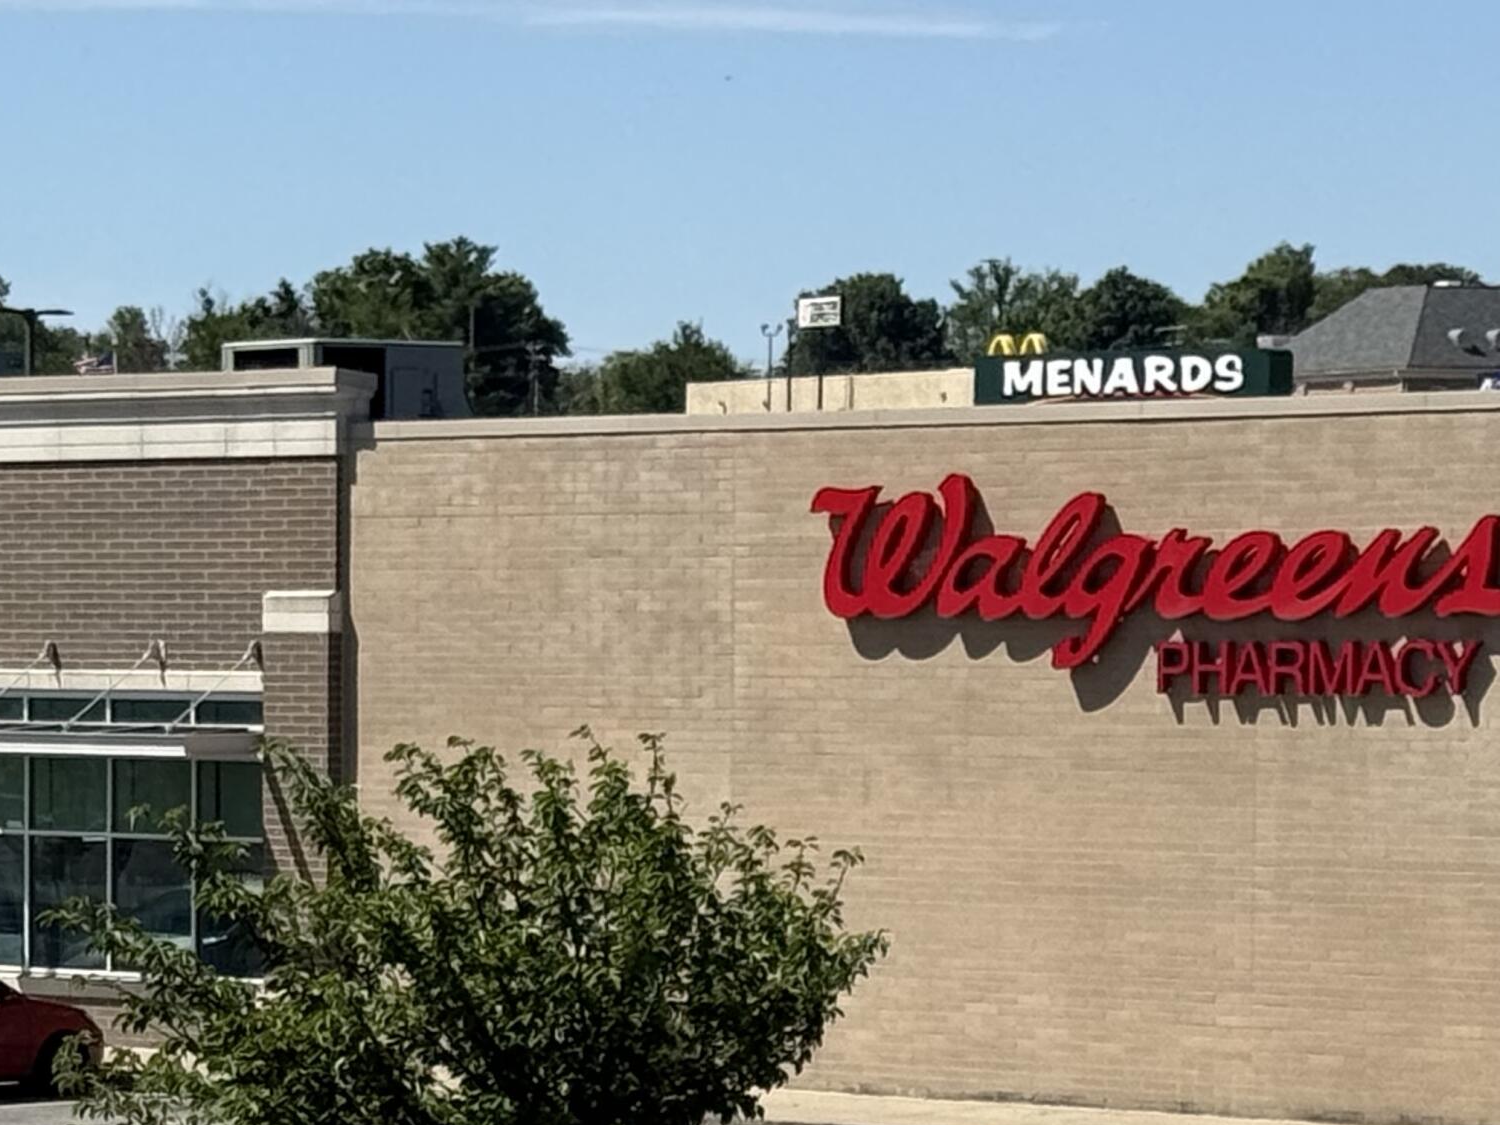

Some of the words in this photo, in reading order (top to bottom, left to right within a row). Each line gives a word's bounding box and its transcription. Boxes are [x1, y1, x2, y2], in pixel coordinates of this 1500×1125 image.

[1003, 354, 1244, 396] MENARDS
[811, 473, 1500, 669] Walgreens
[1157, 640, 1483, 697] PHARMACY
